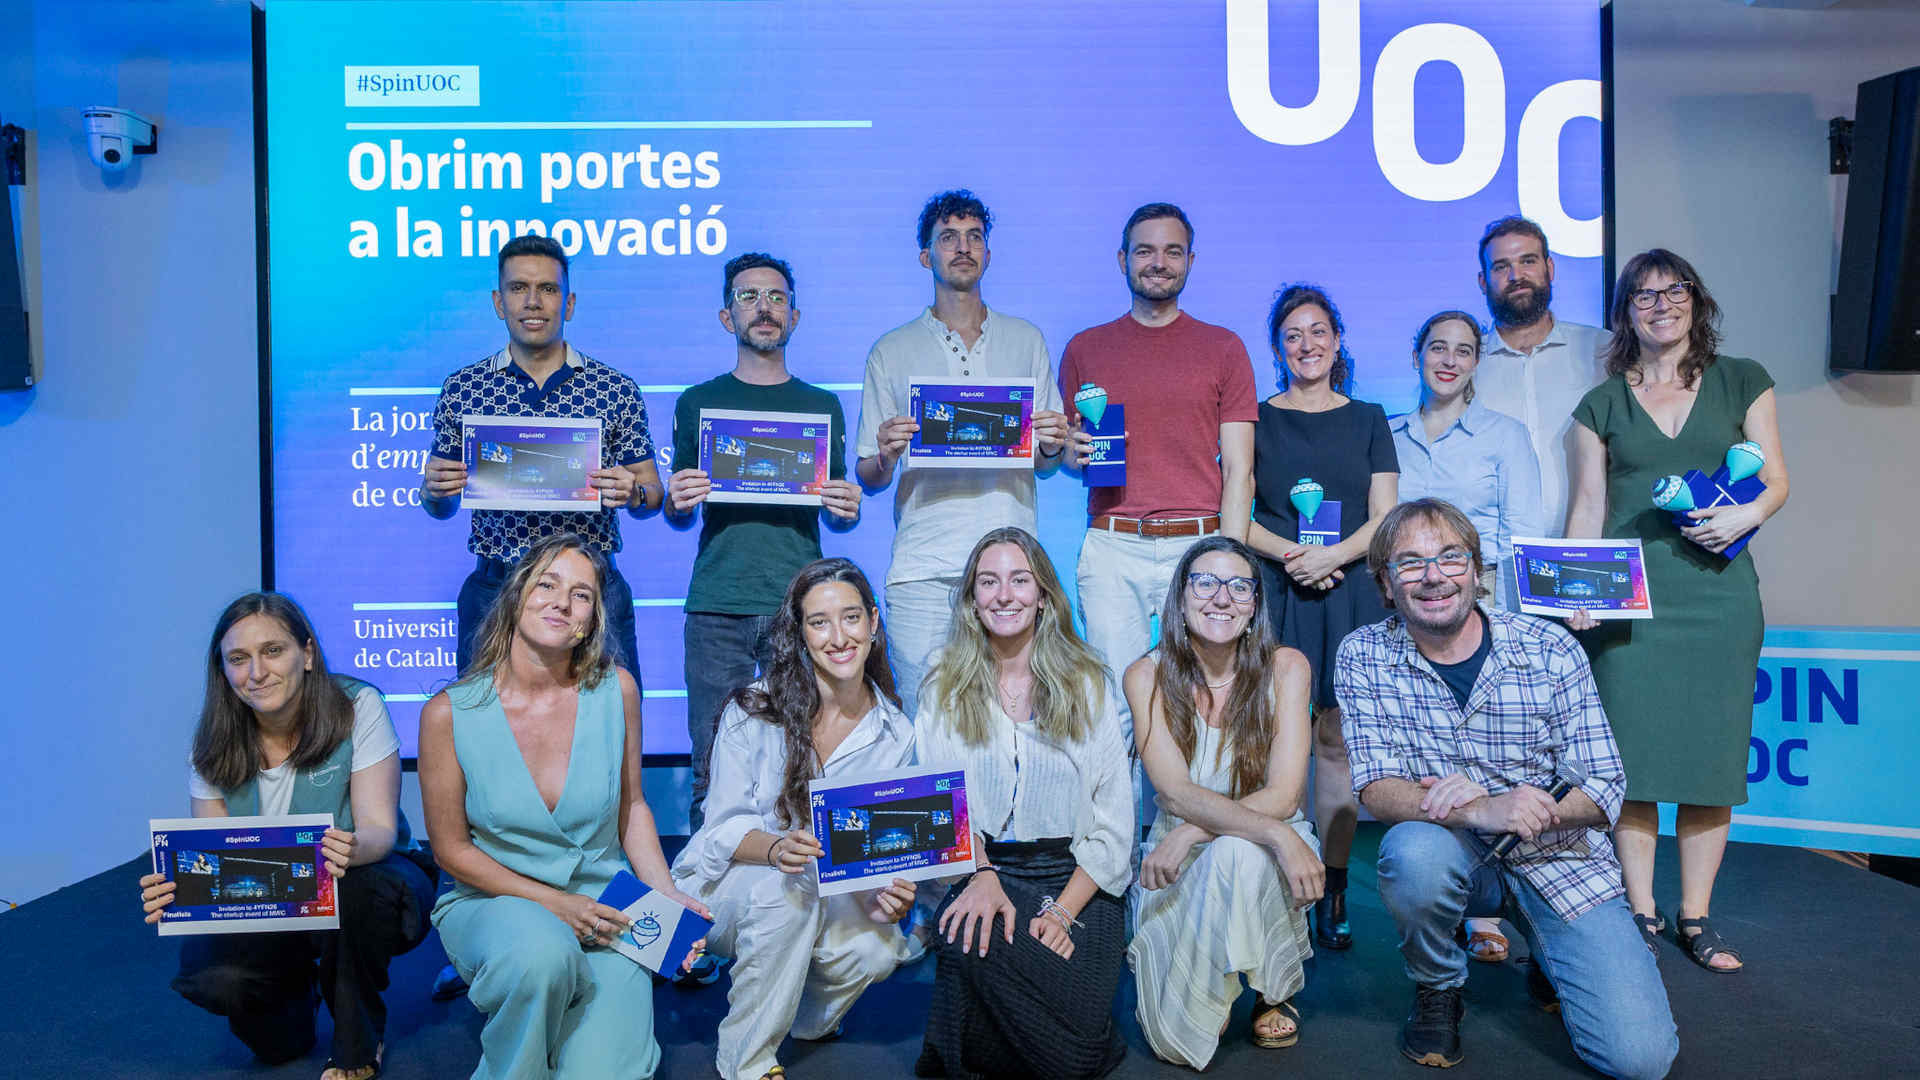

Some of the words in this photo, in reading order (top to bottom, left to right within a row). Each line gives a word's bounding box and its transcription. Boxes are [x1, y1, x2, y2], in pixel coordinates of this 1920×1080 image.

[356, 73, 461, 97] #SpinUOC
[348, 137, 524, 191] Obrim
[540, 144, 721, 203] portes
[348, 219, 380, 258] a
[396, 206, 444, 258] la
[350, 407, 385, 432] La
[352, 481, 386, 507] de
[1300, 535, 1324, 545] SPIN
[354, 647, 381, 669] de
